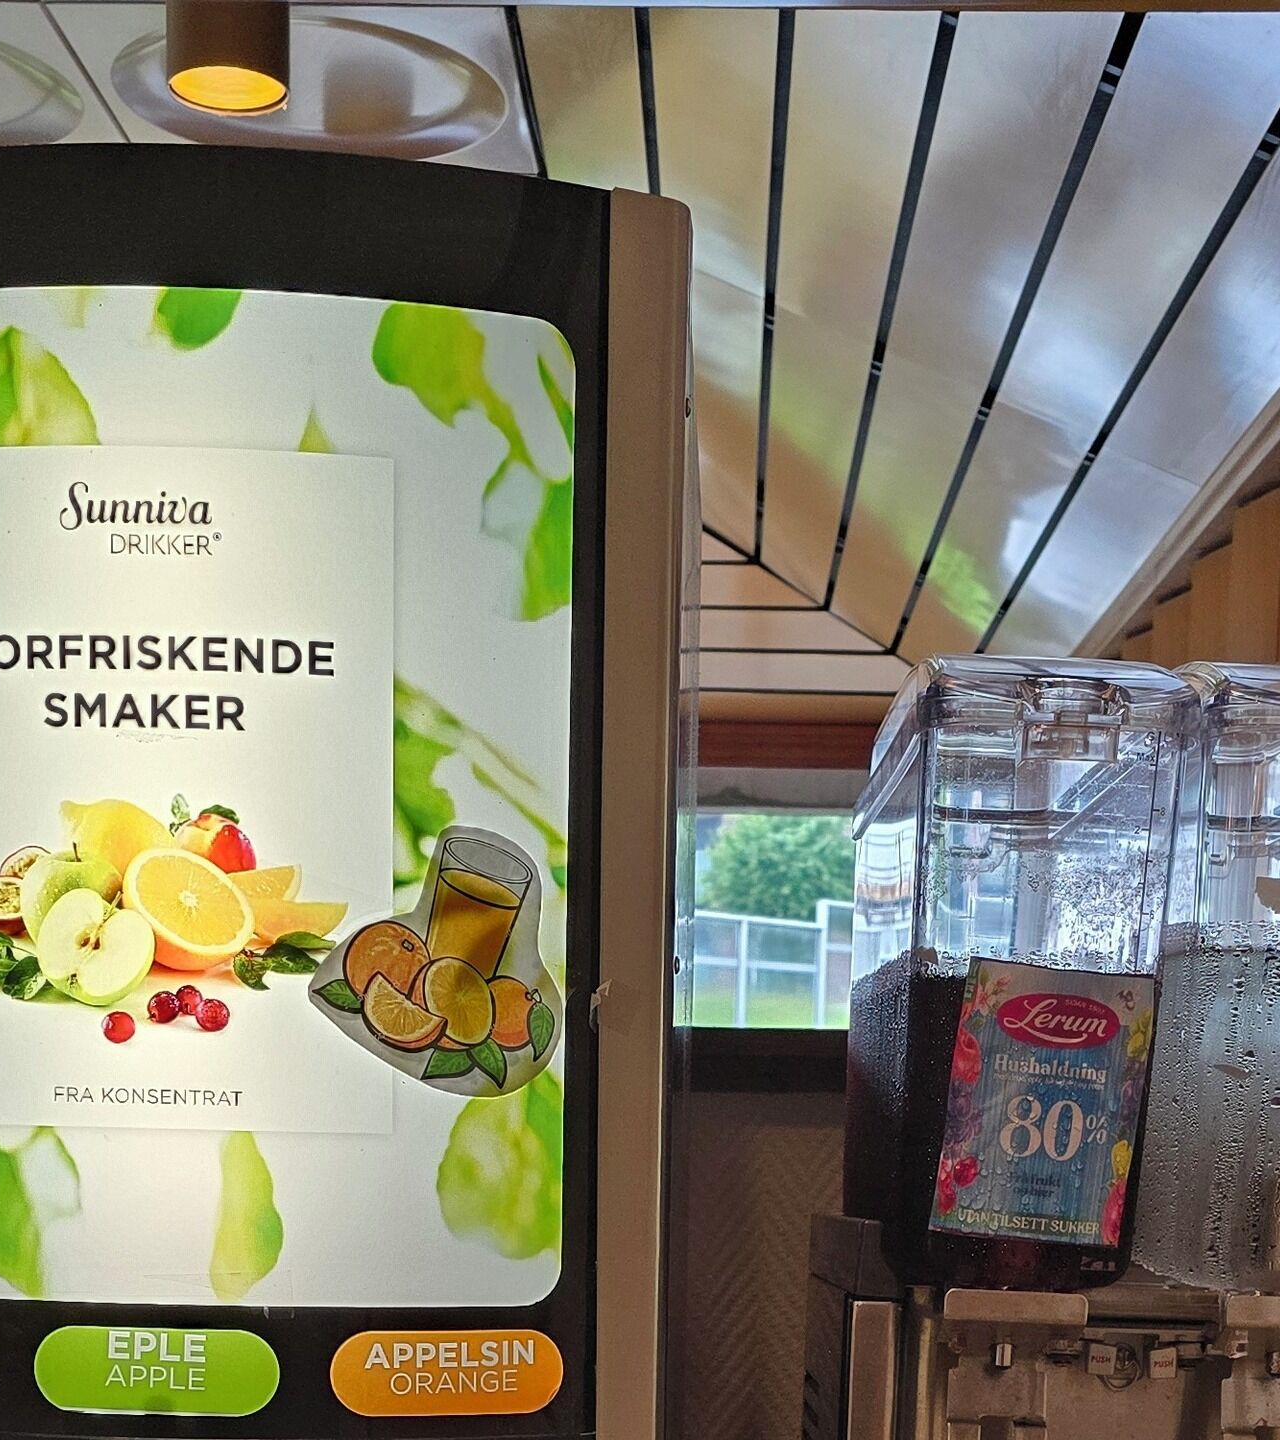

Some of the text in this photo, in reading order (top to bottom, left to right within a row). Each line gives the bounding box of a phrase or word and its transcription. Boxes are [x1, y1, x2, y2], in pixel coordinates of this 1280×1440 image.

[60, 481, 212, 531] Sunniva
[44, 692, 246, 732] SMAKER
[1003, 999, 1108, 1044] Lerum
[994, 1054, 1108, 1083] Hushaldning
[53, 1086, 244, 1108] FRA KONSENTRAT
[958, 1208, 1100, 1235] UTAN TILSETT SUKKER
[106, 1331, 207, 1364] EPLE
[365, 1340, 536, 1370] APPELSIN
[1090, 1355, 1112, 1364] PUSH
[1153, 1359, 1174, 1368] PUSH
[104, 1364, 207, 1392] APPLE
[389, 1370, 520, 1396] ORANGE
